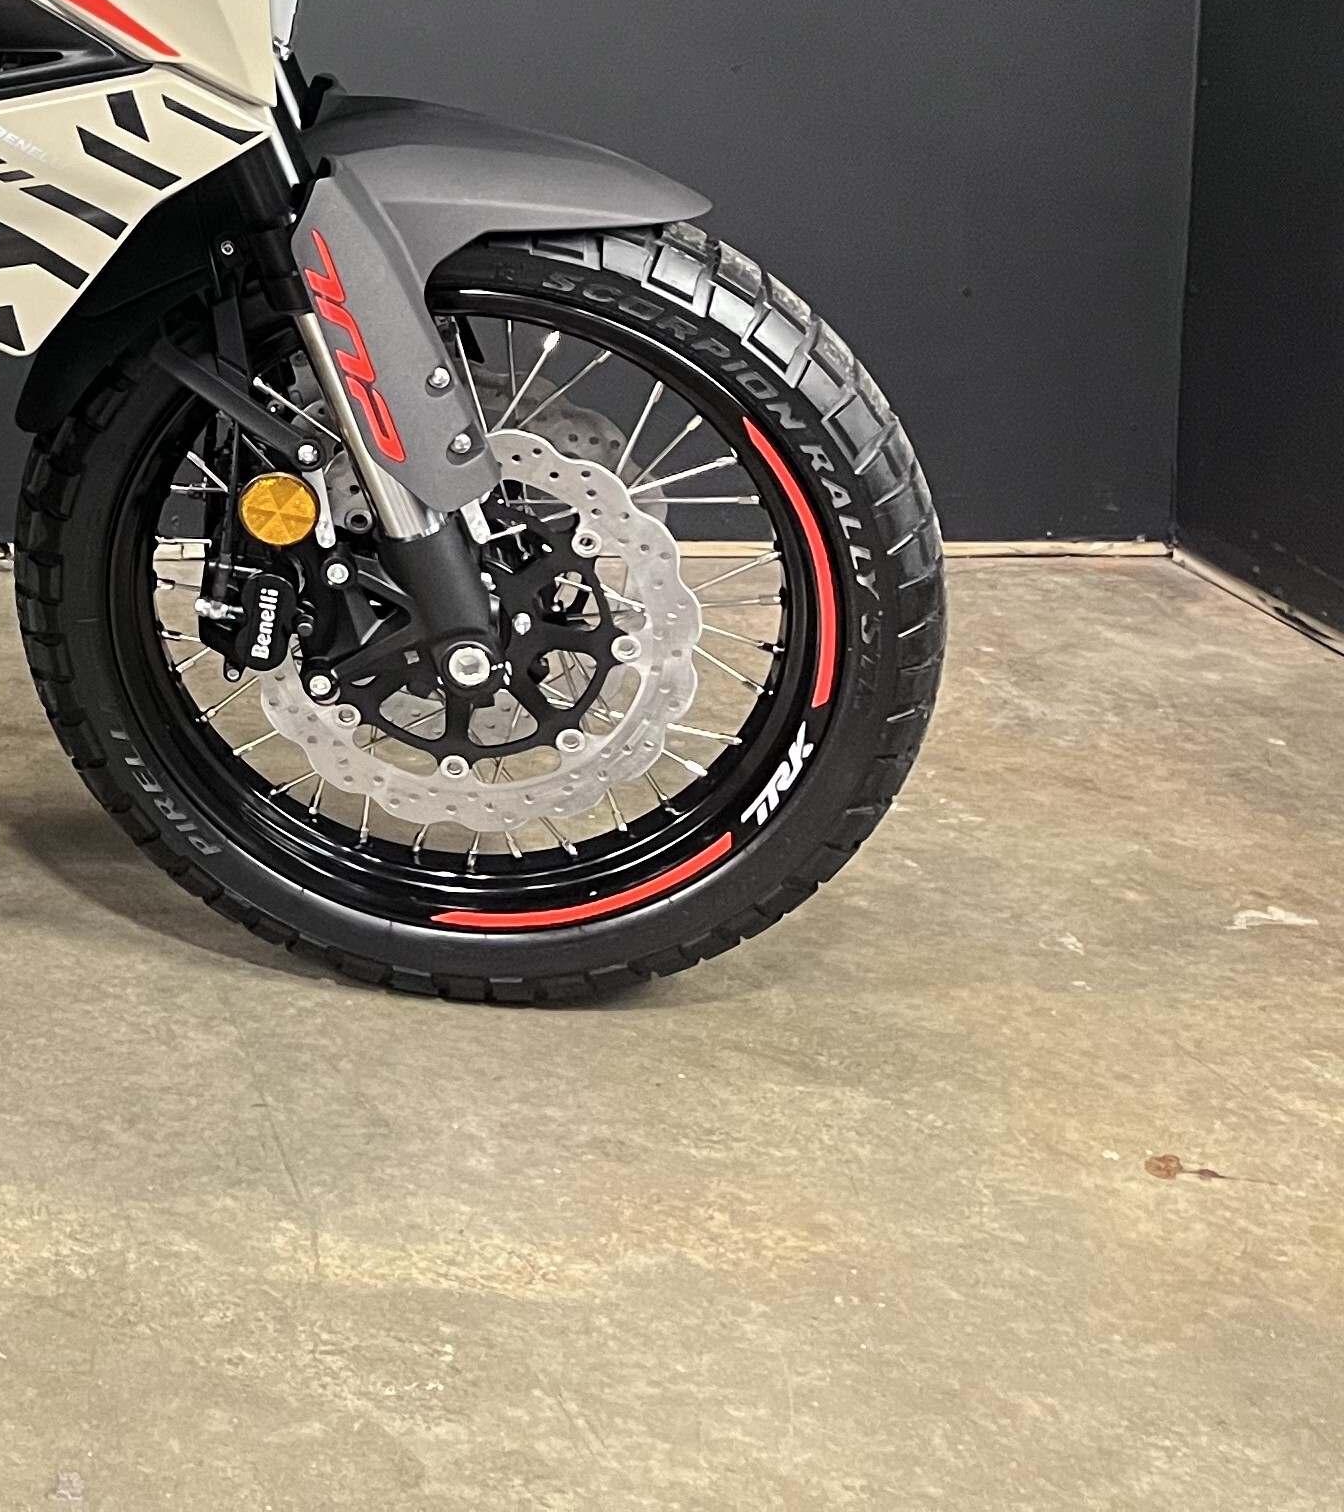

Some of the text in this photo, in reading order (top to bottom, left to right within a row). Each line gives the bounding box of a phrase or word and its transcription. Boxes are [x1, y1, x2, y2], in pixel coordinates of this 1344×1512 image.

[541, 271, 807, 430] SCORPION
[799, 444, 880, 601] RALLY
[250, 588, 279, 660] Benelli
[740, 720, 815, 826] TRK
